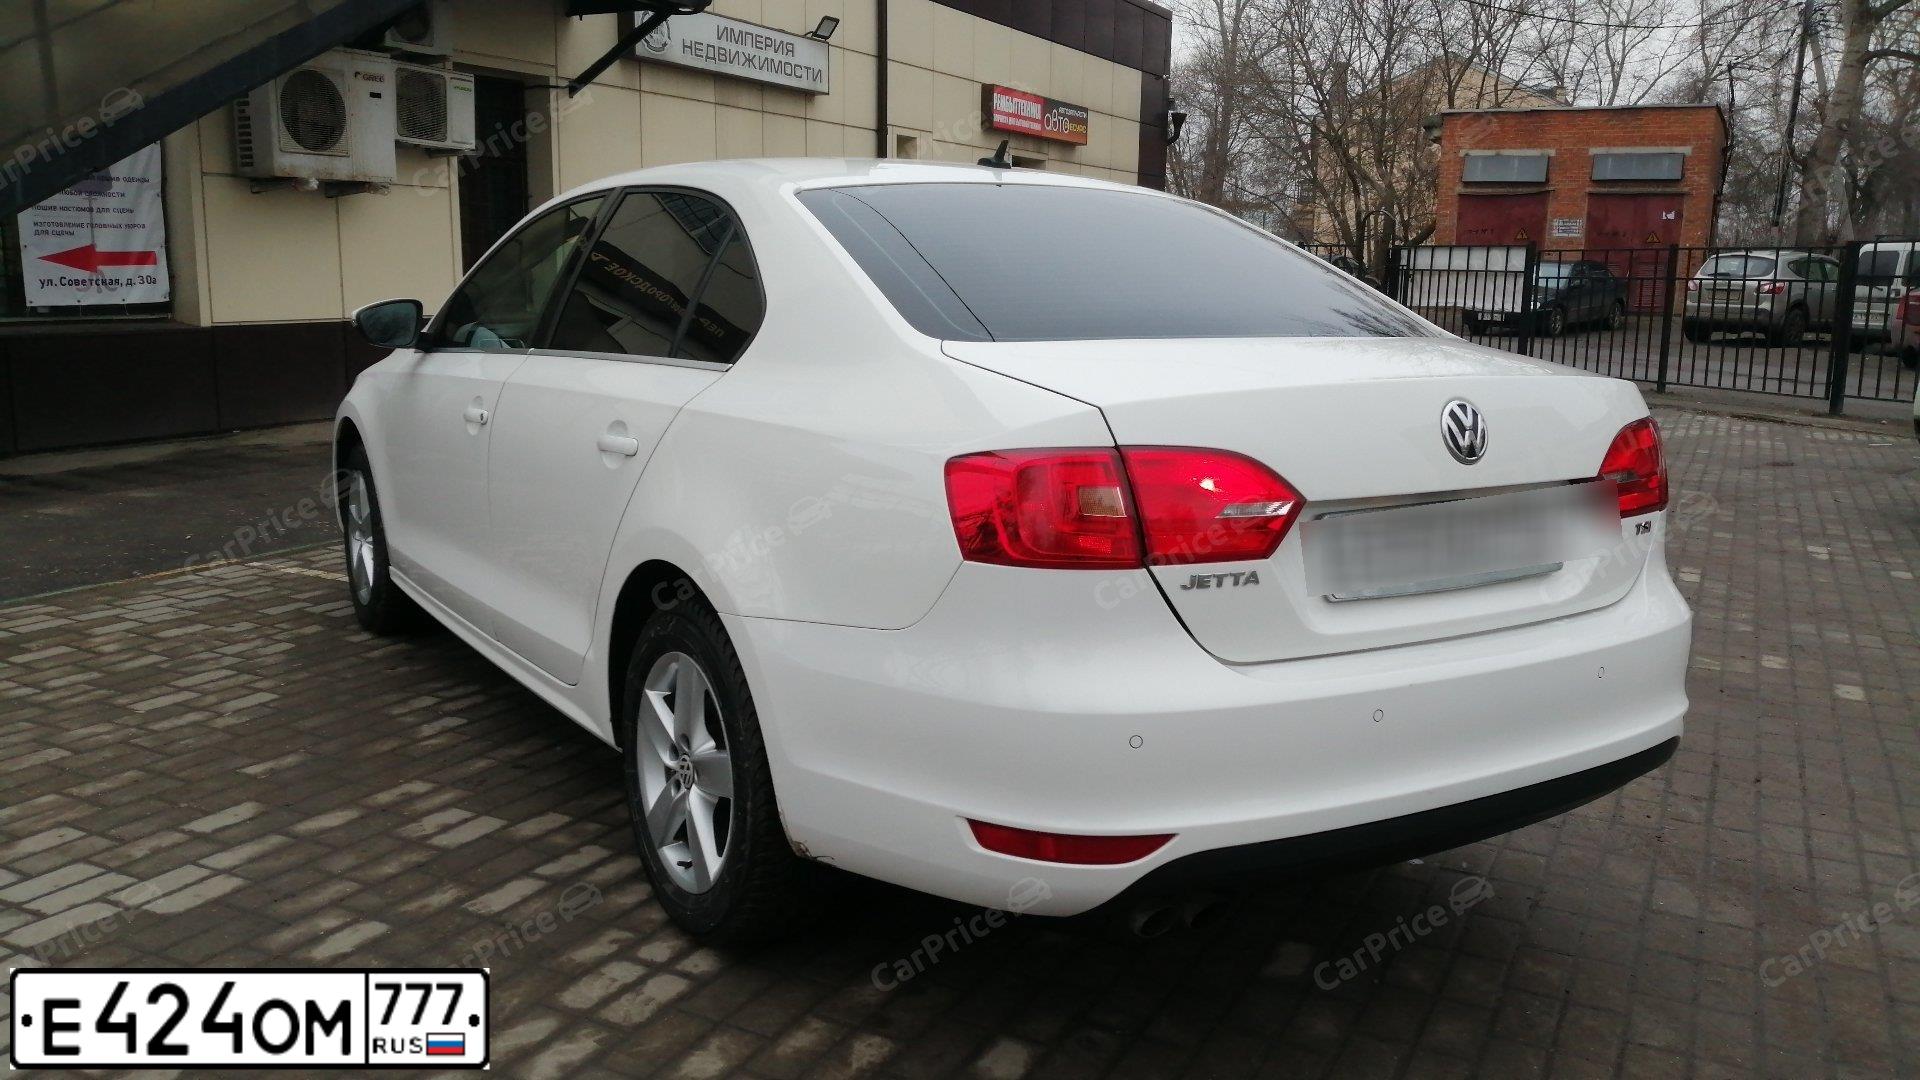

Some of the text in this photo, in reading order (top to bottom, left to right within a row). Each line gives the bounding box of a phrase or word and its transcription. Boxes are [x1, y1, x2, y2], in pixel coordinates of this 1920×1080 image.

[716, 24, 795, 57] ИМПЕРИЯ
[682, 38, 822, 83] НЕДВИЖИМОСТИ
[39, 278, 58, 289] ул.
[59, 276, 123, 288] Советская,
[125, 279, 136, 287] д.
[1635, 520, 1652, 536] TSI
[1180, 570, 1260, 590] JETTA
